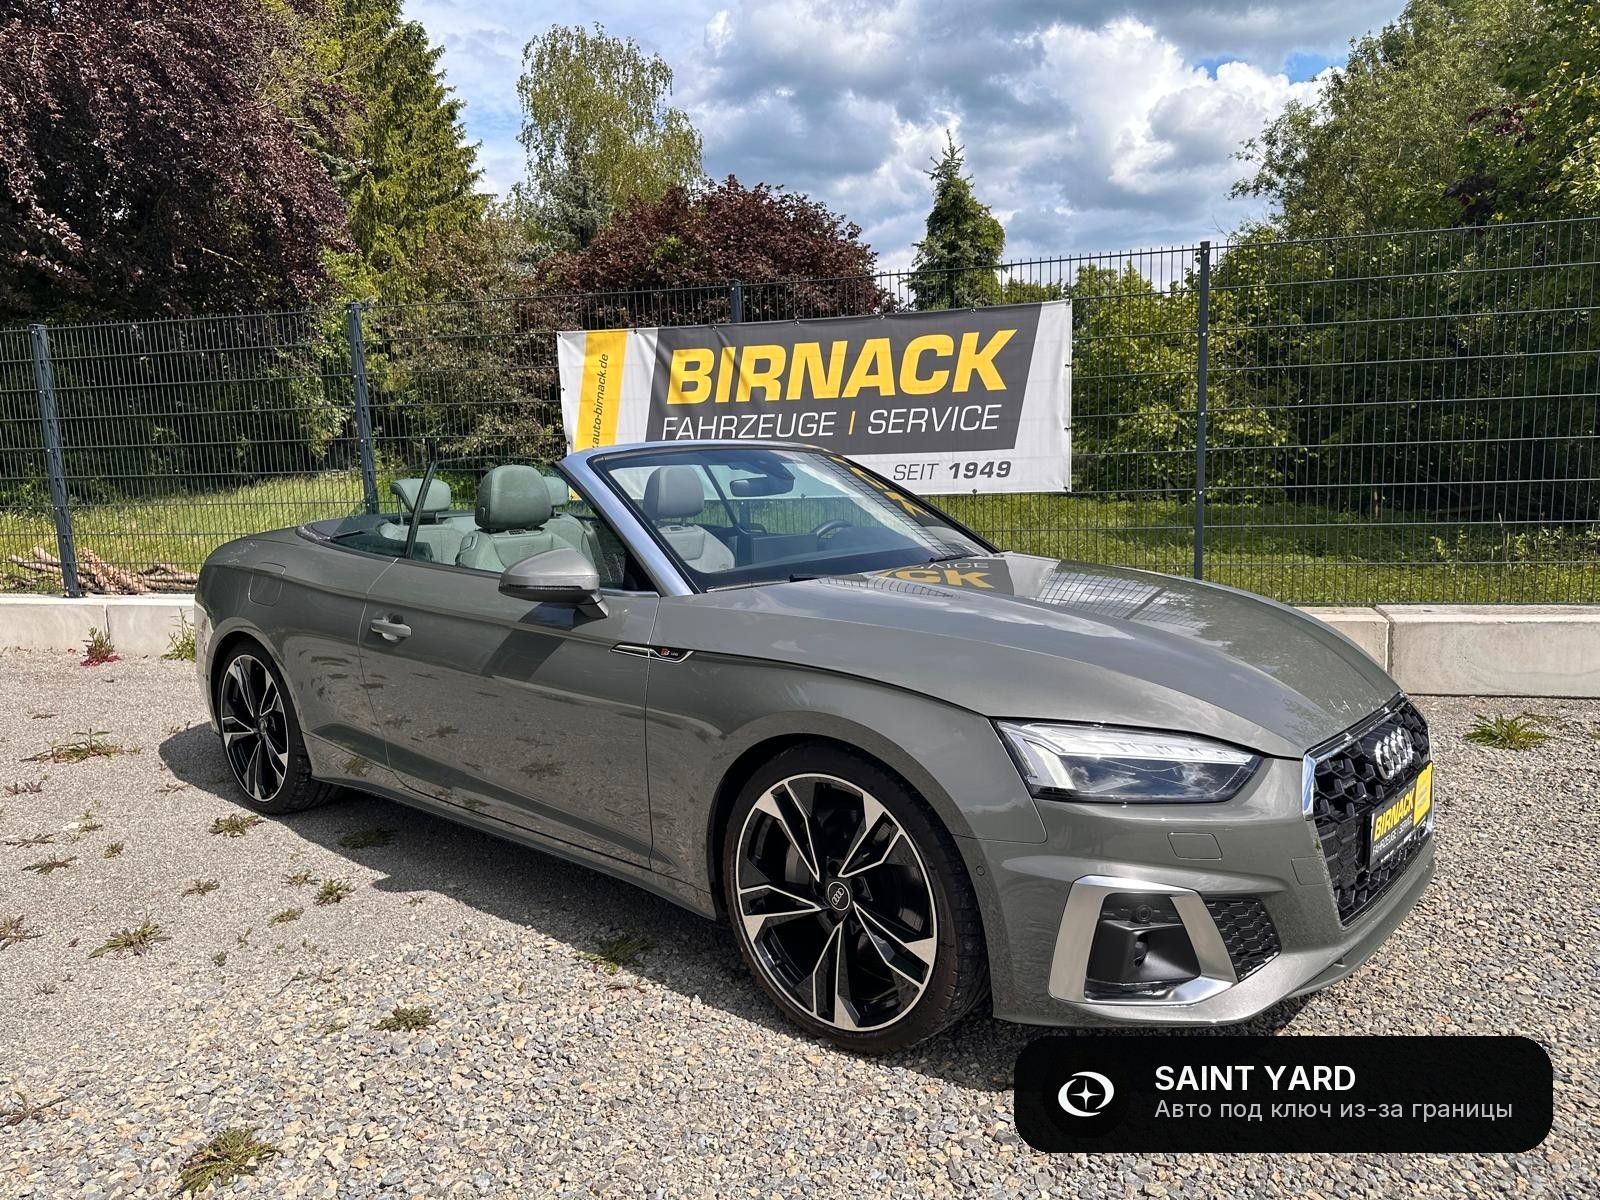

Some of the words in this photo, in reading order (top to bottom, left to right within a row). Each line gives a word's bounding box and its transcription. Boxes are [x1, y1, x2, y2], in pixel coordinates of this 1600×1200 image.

[666, 329, 1018, 405] BIRNACK
[591, 353, 609, 448] .auto-birnack.de
[662, 411, 838, 440] FAHRZEUGE
[868, 404, 1003, 435] SERVICE
[893, 463, 939, 481] SEIT
[948, 461, 1012, 480] 1949
[1374, 787, 1415, 842] BIRNACK
